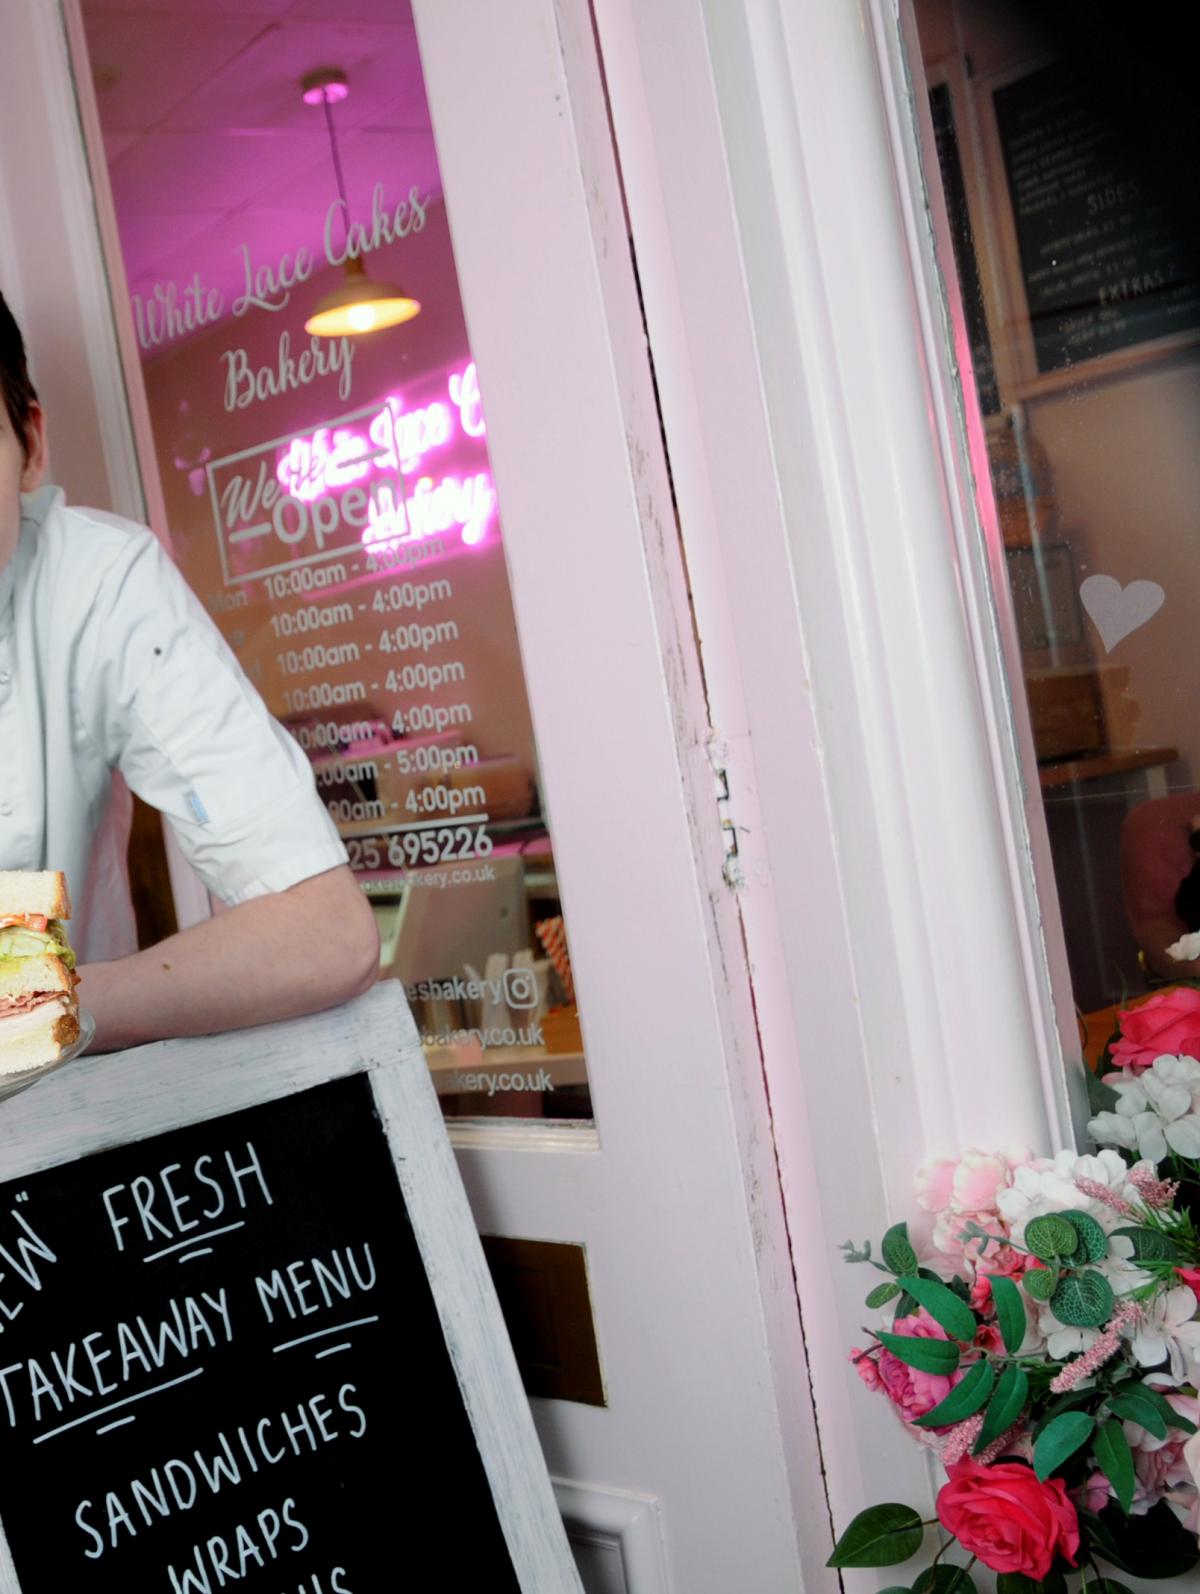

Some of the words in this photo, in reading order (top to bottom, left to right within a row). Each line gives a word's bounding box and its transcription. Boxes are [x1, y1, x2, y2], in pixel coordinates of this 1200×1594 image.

[132, 272, 225, 349] White
[231, 243, 314, 314] Lace
[323, 182, 433, 267] Cakes
[220, 330, 355, 412] Bakery
[220, 460, 281, 528] We
[272, 478, 398, 549] Open
[264, 563, 347, 599] 10:00am
[365, 539, 445, 571] 4:00pm
[270, 602, 354, 637] 10:00am
[372, 578, 452, 613] 4:00pm
[276, 641, 360, 676] 10:00am
[378, 620, 459, 654] 4:00pm
[283, 681, 367, 713] 10:00am
[384, 661, 465, 693] 4:00pm
[391, 703, 473, 733] 4:00pm
[396, 744, 478, 774] 5:00pm
[405, 785, 486, 815] 4:00pm
[387, 824, 494, 867] 695226
[101, 1141, 274, 1251] FRESH
[255, 1243, 377, 1324] MENU
[74, 1383, 368, 1559] SANDWICHES
[167, 1498, 309, 1594] WRAPS
